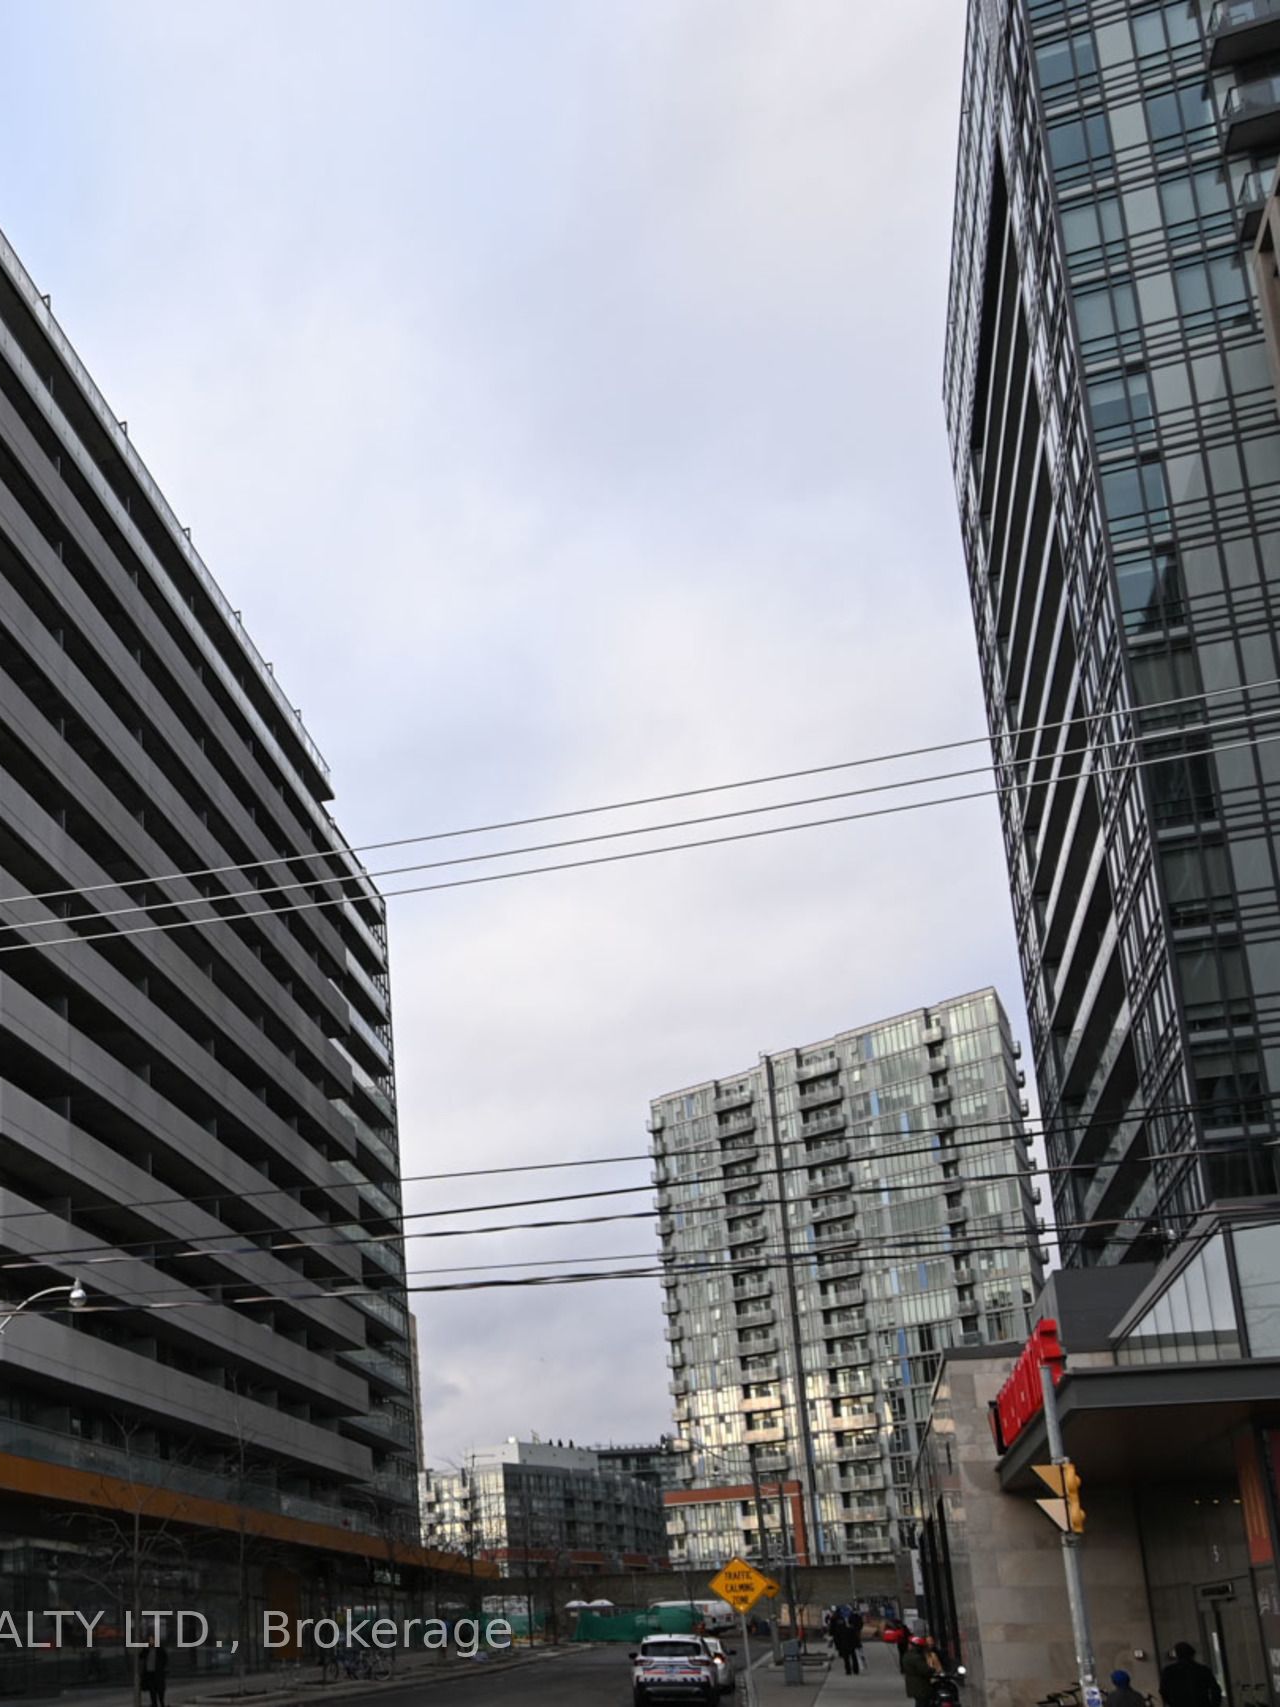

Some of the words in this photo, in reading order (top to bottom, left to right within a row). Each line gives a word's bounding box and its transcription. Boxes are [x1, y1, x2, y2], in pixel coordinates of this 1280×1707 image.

[725, 1570, 753, 1580] TRAFFIC
[725, 1583, 755, 1593] CALMING
[732, 1595, 749, 1605] ZONE
